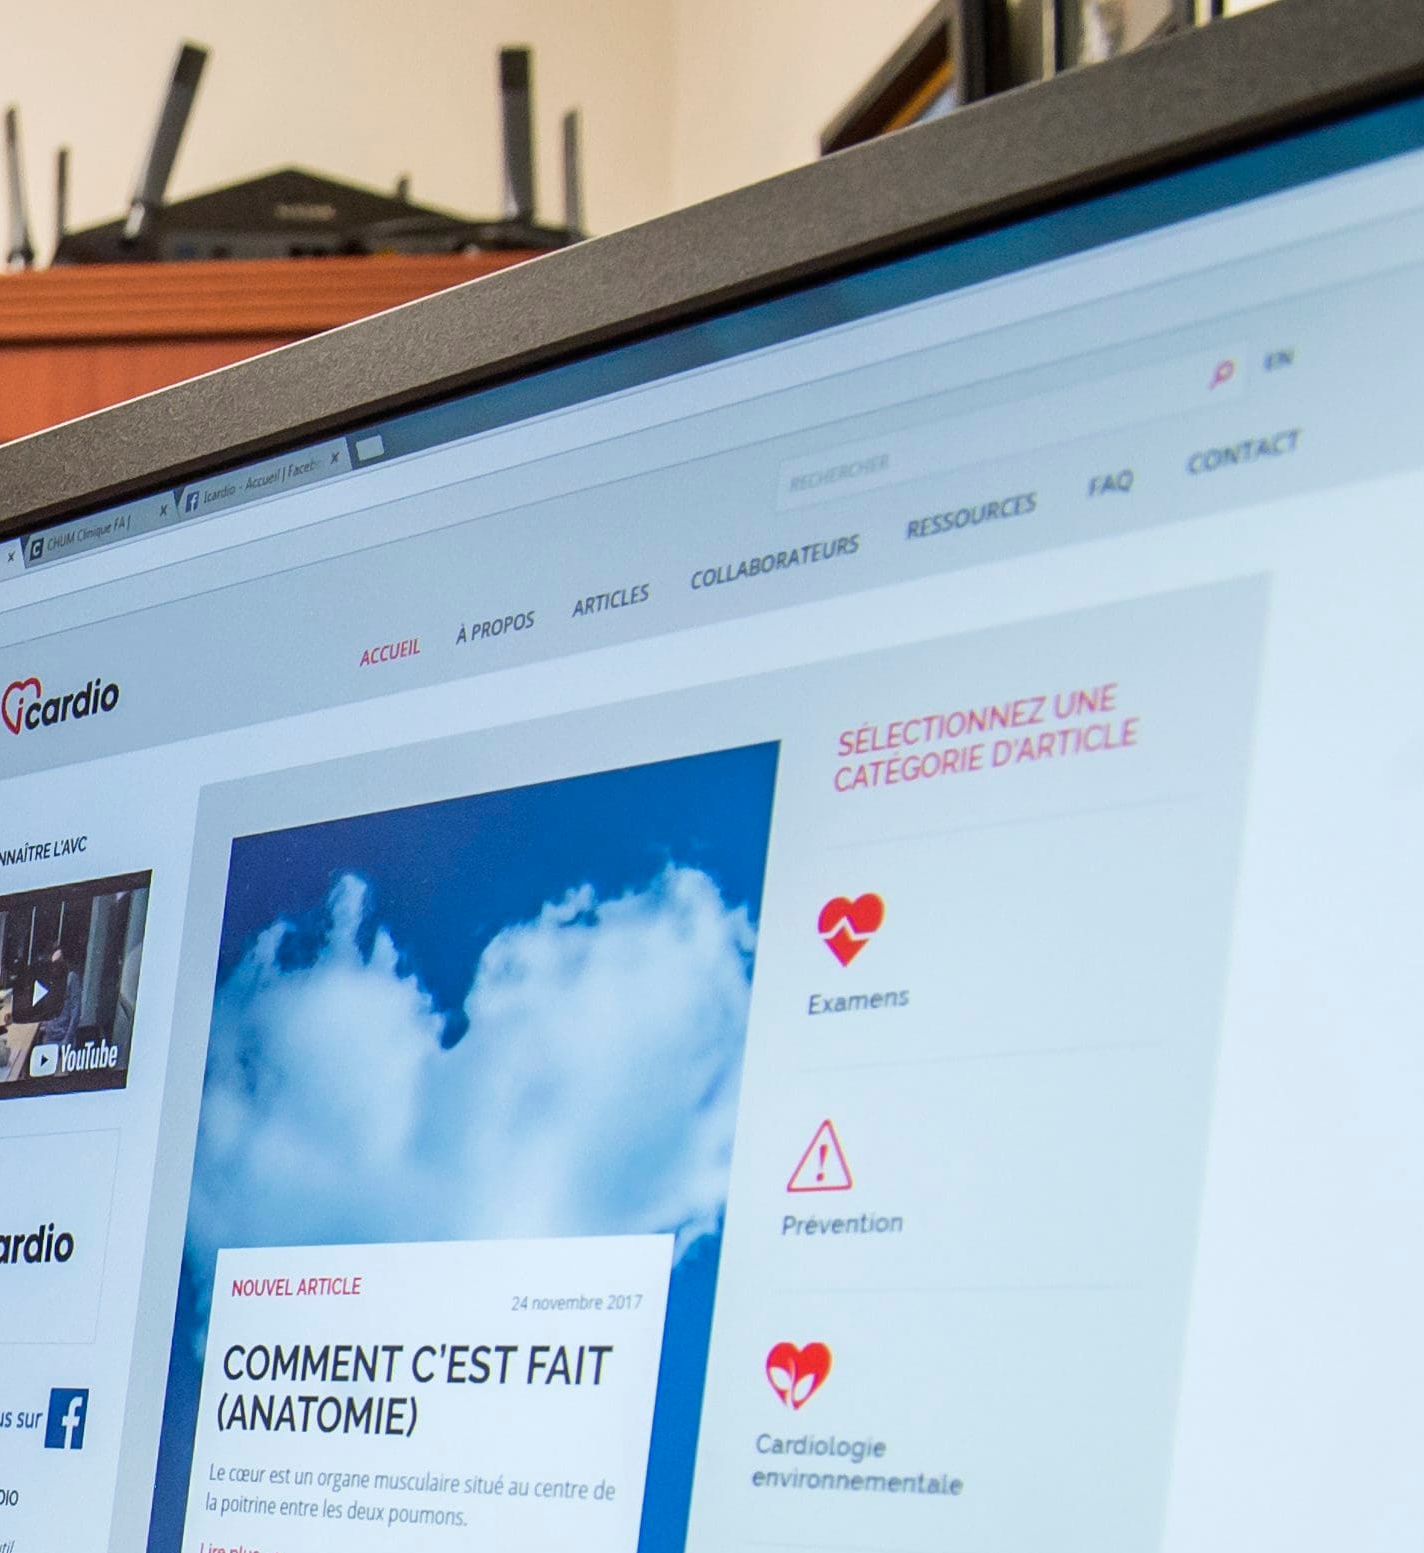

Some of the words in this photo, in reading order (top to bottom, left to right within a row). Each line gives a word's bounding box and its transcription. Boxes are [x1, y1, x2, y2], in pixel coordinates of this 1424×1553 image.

[1186, 428, 1303, 476] CONTACT
[1087, 468, 1135, 498] FAQ
[906, 492, 1038, 541] RESSOURCES
[690, 534, 860, 591] COLLABORATEURS
[572, 584, 651, 618] ARTICLES
[455, 622, 468, 646] À
[471, 610, 536, 641] PROPOS
[359, 638, 421, 668] ACCUEIL
[838, 695, 1047, 757] SÉLECTIONNEZ
[1053, 681, 1118, 721] UNE
[833, 747, 985, 793] CATÉGORIE
[991, 717, 1140, 768] D'ARTICLE
[53, 835, 88, 859] L'AVC
[808, 988, 911, 1016] Examens
[60, 1038, 118, 1073] YouTube
[782, 1212, 904, 1236] Prévention
[231, 1277, 293, 1297] NOUVEL
[297, 1277, 362, 1296] ARTICLE
[511, 1296, 528, 1311] 24
[531, 1294, 603, 1311] novembre
[607, 1293, 643, 1310] 2017
[223, 1344, 404, 1382] COMMENT
[411, 1343, 518, 1384] C'EST
[526, 1345, 613, 1386] FAIT
[16, 1411, 43, 1429] sur
[217, 1392, 418, 1437] (ANATOMIE)
[756, 1433, 887, 1464] Cardiologie
[209, 1463, 226, 1482] Le
[229, 1467, 266, 1484] cœur
[269, 1467, 291, 1485] est
[294, 1470, 313, 1487] un
[317, 1473, 371, 1493] organe
[374, 1470, 460, 1495] musculaire
[464, 1473, 504, 1496] situé
[508, 1481, 530, 1498] au
[534, 1480, 589, 1500] centre
[594, 1480, 616, 1502] de
[752, 1467, 964, 1497] environnementale
[205, 1492, 218, 1511] la
[220, 1493, 277, 1518] poitrine
[279, 1500, 319, 1518] entre
[322, 1499, 343, 1519] les
[347, 1501, 384, 1522] deux
[388, 1508, 469, 1528] poumons.
